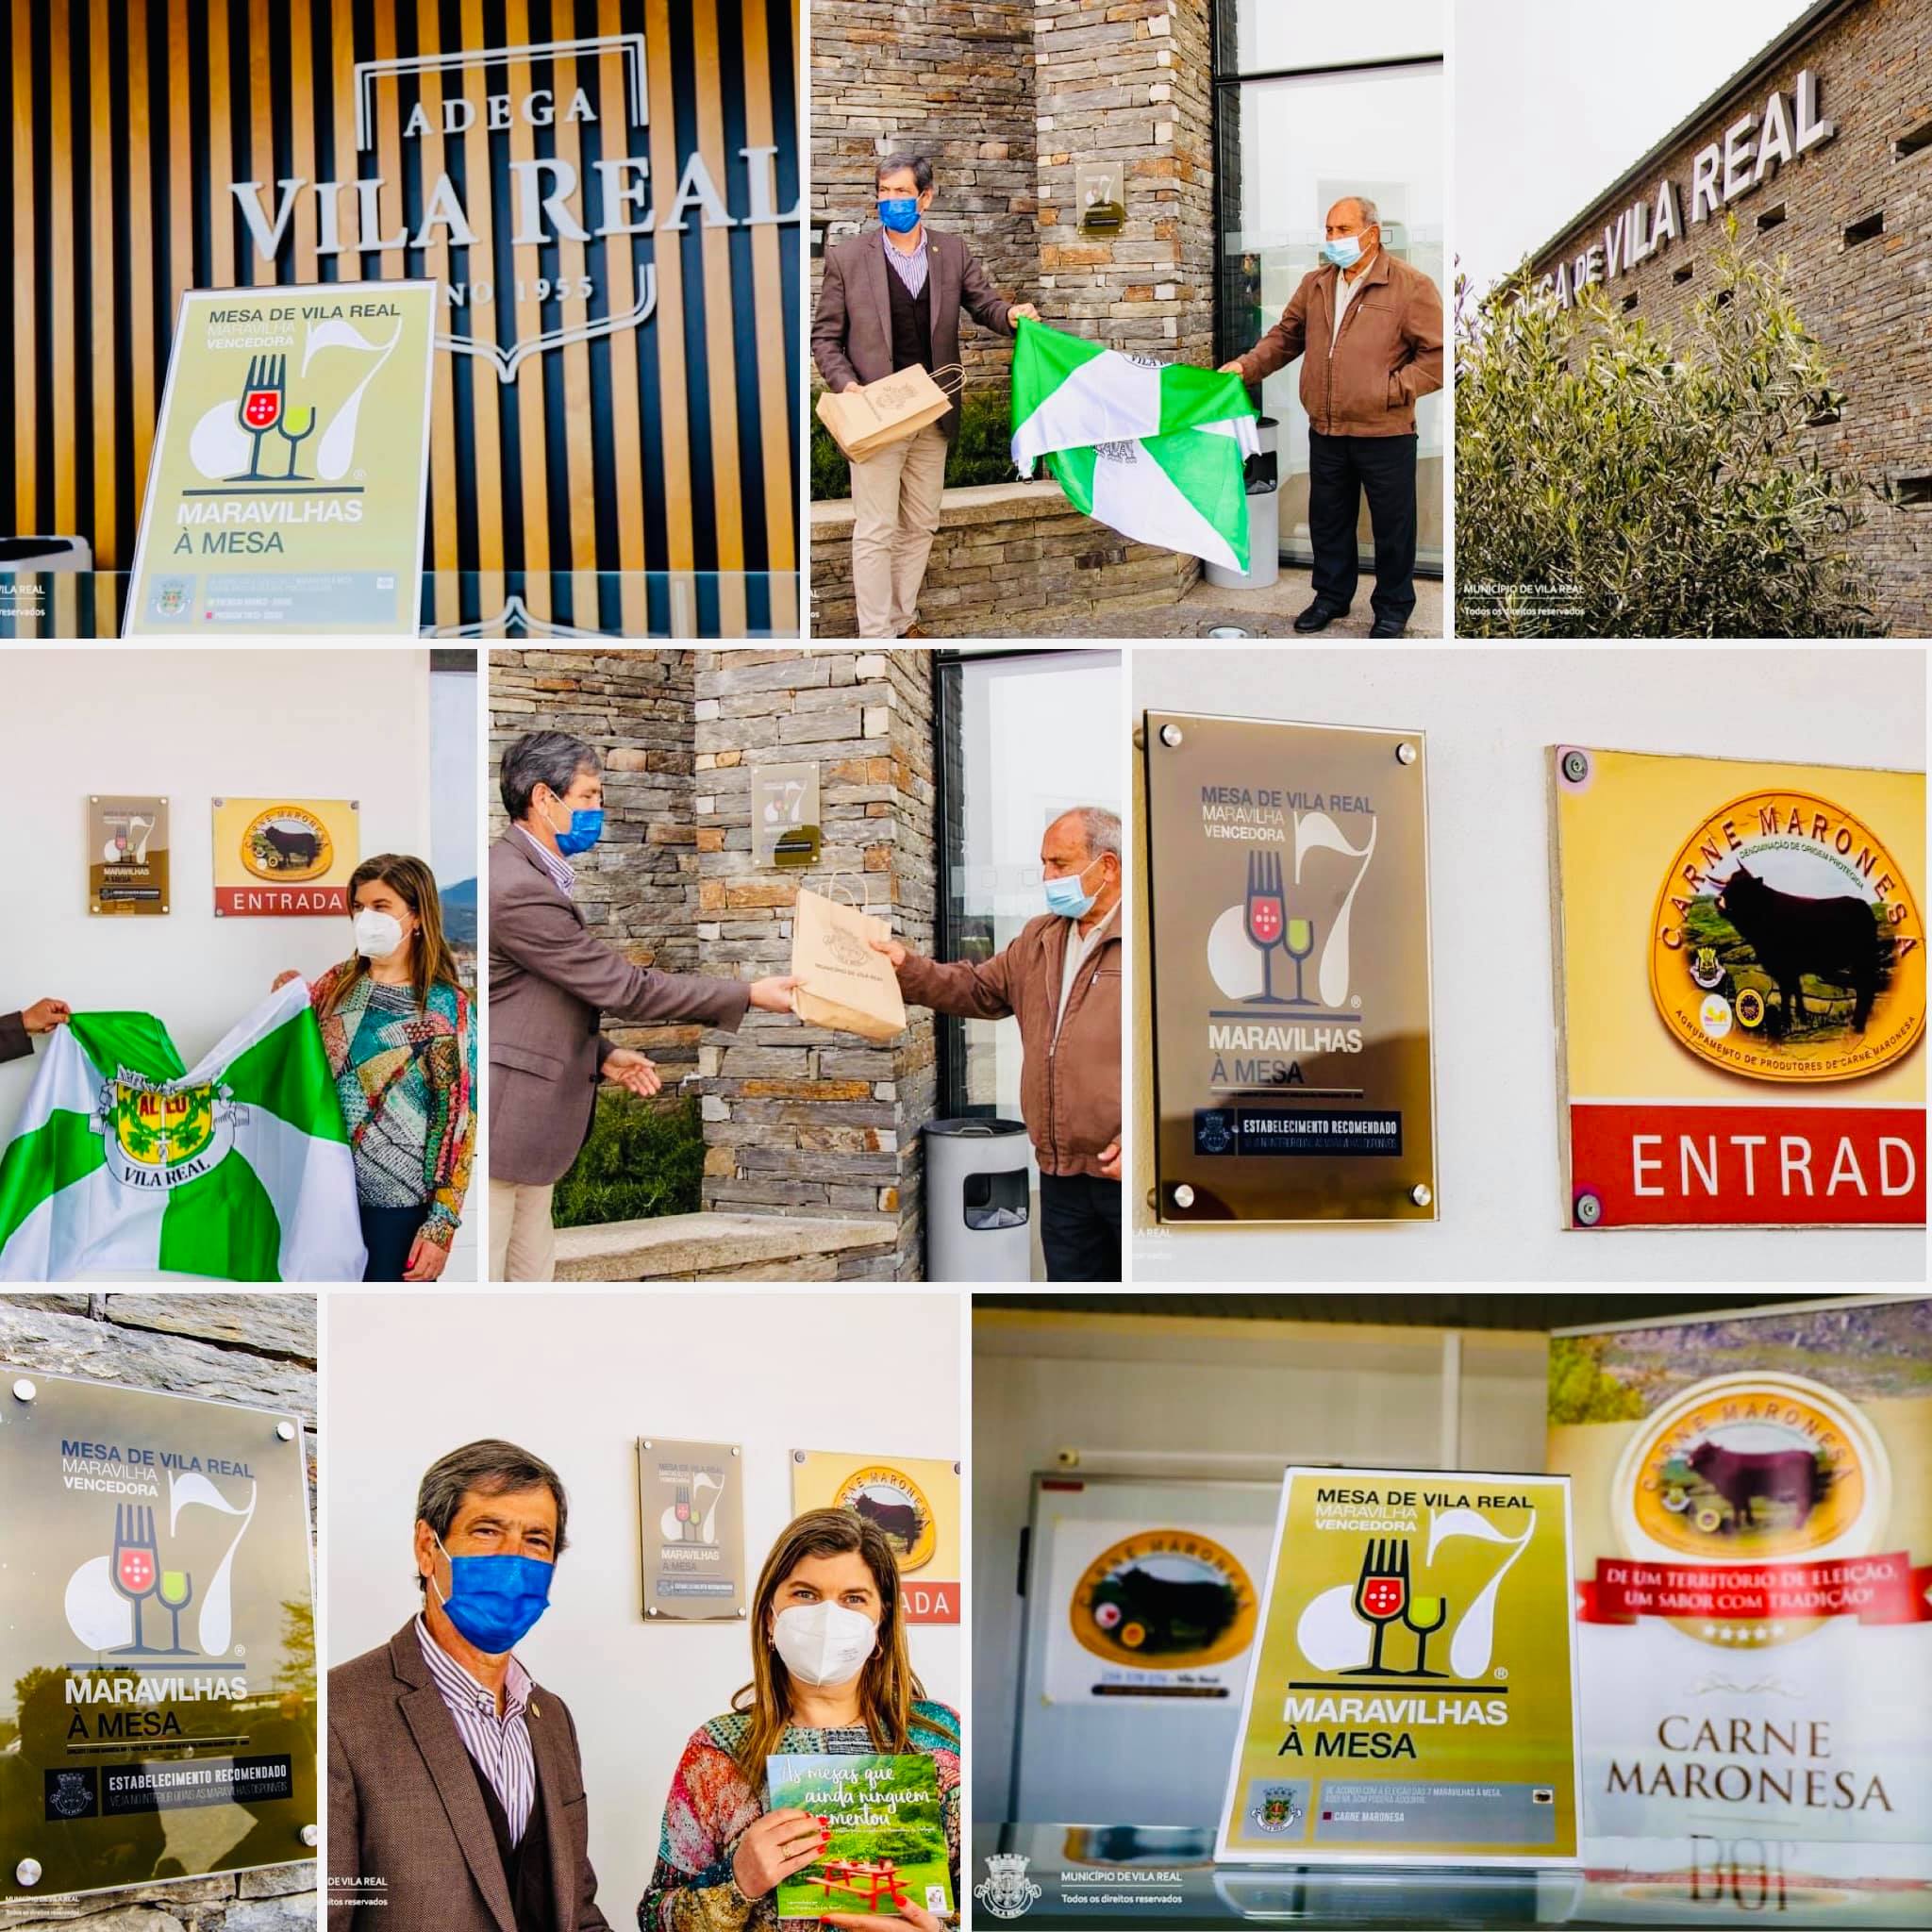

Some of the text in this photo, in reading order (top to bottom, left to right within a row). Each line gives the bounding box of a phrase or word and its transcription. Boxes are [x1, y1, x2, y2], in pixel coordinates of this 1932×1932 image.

[404, 87, 598, 138] ADEGA
[1574, 243, 1605, 293] DE
[1606, 180, 1684, 280] VILA
[1692, 69, 1834, 224] REAL
[227, 145, 800, 261] VILA REAL
[445, 275, 594, 307] NO 1955
[209, 303, 401, 324] MESA DE VILA REAL
[208, 322, 295, 336] MARAVILHA
[207, 337, 294, 350] VENCEDORA
[176, 499, 363, 525] MARAVILHAS
[174, 526, 285, 554] À MESA
[1202, 787, 1374, 813] MESA DE VILA REAL
[1202, 806, 1285, 824] MARAVILHA
[1204, 824, 1286, 841] VENCEDORA
[1790, 841, 1800, 850] DE
[1660, 805, 1917, 957] CARNE MARONESA
[234, 893, 342, 909] ENTRADA
[1208, 1024, 1363, 1053] MARAVILHAS
[1675, 1009, 1916, 1072] AGRUPAMENTO DE PRODUTORES DE CARNE MARONESA
[1210, 1052, 1305, 1084] À MESA
[1243, 1120, 1397, 1135] ESTABELECIMENTO RECOMENDADO
[125, 1158, 210, 1187] VILA REAL
[1632, 1135, 1916, 1196] ENTRAD
[61, 1440, 255, 1478] MESA DE VILA REAL
[1643, 1402, 1854, 1491] CARNE MARONESA
[62, 1457, 158, 1482] MARAVILHA
[63, 1476, 158, 1497] VENCEDORA
[1317, 1489, 1534, 1508] MESA DE VILA REAL
[838, 1473, 930, 1528] RNE MARONESA
[1316, 1506, 1418, 1519] MARAVILHA
[1315, 1520, 1417, 1532] VENCEDORA
[661, 1548, 720, 1562] MARAVILHAS
[672, 1561, 696, 1572] MESA
[1607, 1567, 1627, 1585] DE
[1633, 1568, 1662, 1586] UM
[1667, 1569, 1775, 1590] TERRITÓRIO
[1781, 1571, 1807, 1587] DE
[1624, 1590, 1653, 1607] UM
[1658, 1591, 1713, 1610] SABOR
[1717, 1592, 1763, 1609] COM
[65, 1676, 247, 1705] MARAVILHAS
[67, 1707, 182, 1740] À MESA
[1283, 1696, 1508, 1725] MARAVILHAS
[1278, 1724, 1417, 1758] À MESA
[1657, 1715, 1831, 1758] CARNE
[108, 1764, 287, 1791] ESTABELECIMENTO RECOMENDADO
[808, 1767, 858, 1784] mesas
[865, 1767, 895, 1788] que
[1607, 1759, 1893, 1812] MARONESA
[806, 1781, 929, 1814] ainda ninguém
[1433, 1788, 1474, 1797] MARAVILHAS
[1334, 1811, 1405, 1822] CARNE MARONESA
